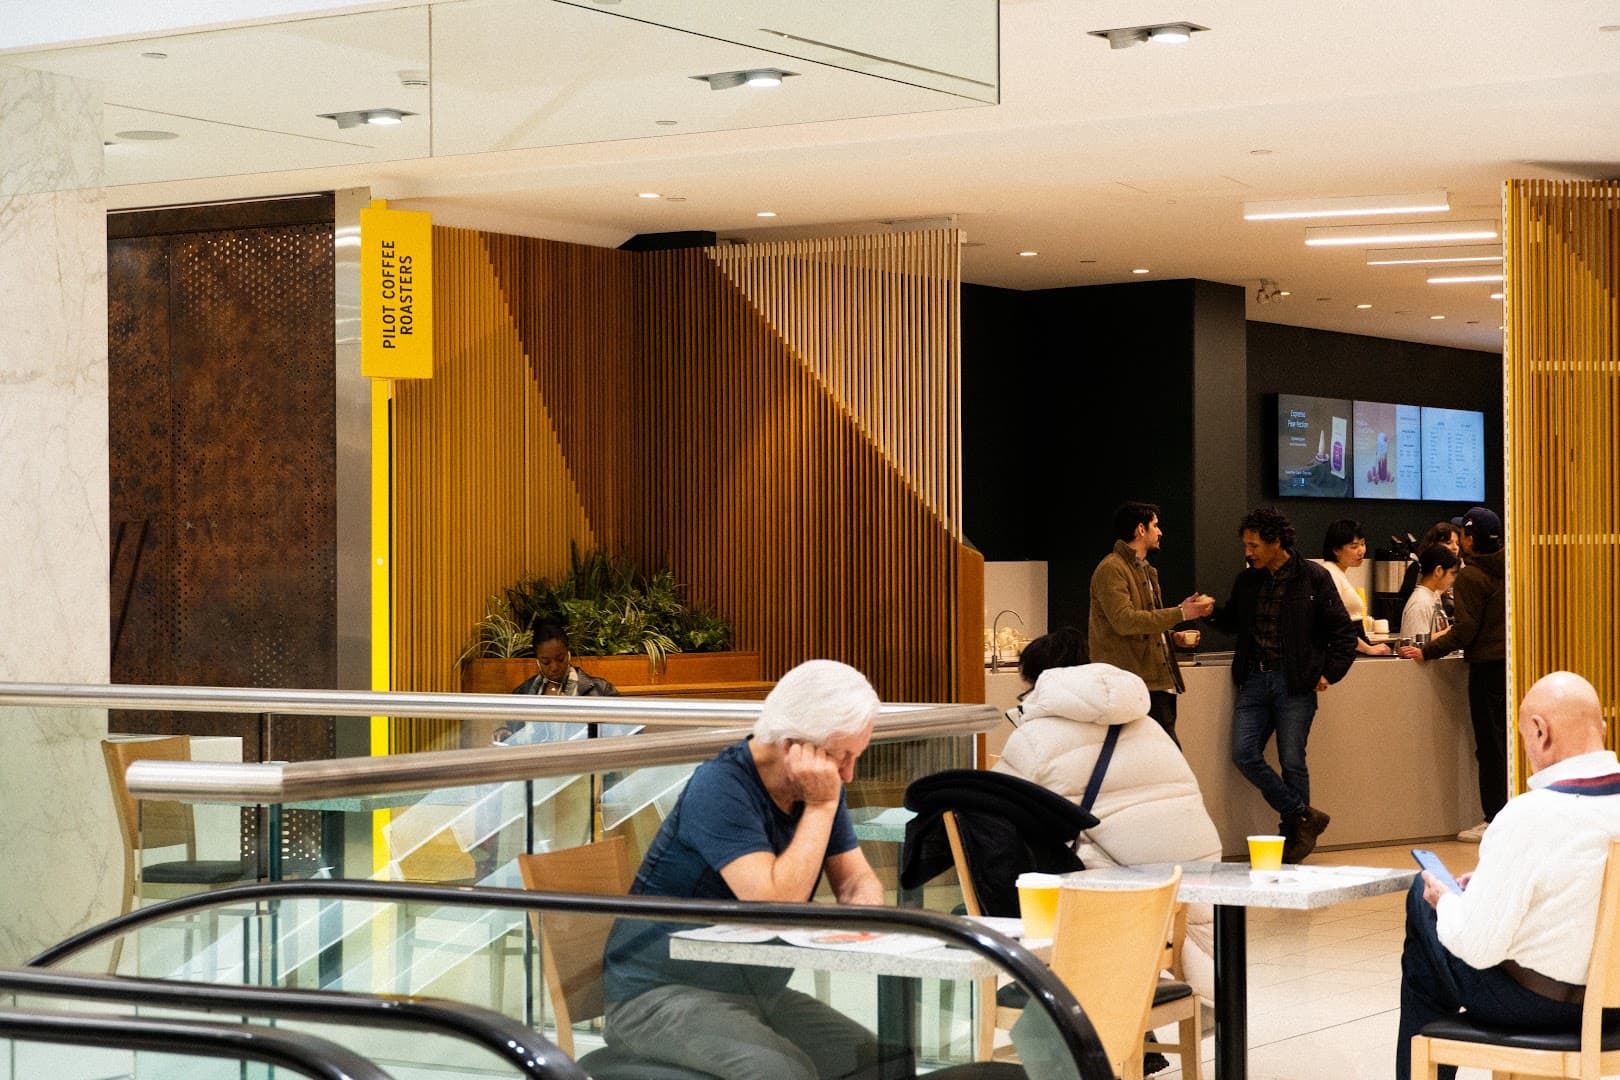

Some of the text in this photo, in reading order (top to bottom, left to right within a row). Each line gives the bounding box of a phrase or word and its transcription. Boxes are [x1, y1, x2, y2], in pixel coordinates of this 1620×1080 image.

[382, 240, 396, 349] PILOT COFFEE
[399, 255, 413, 335] ROASTERS
